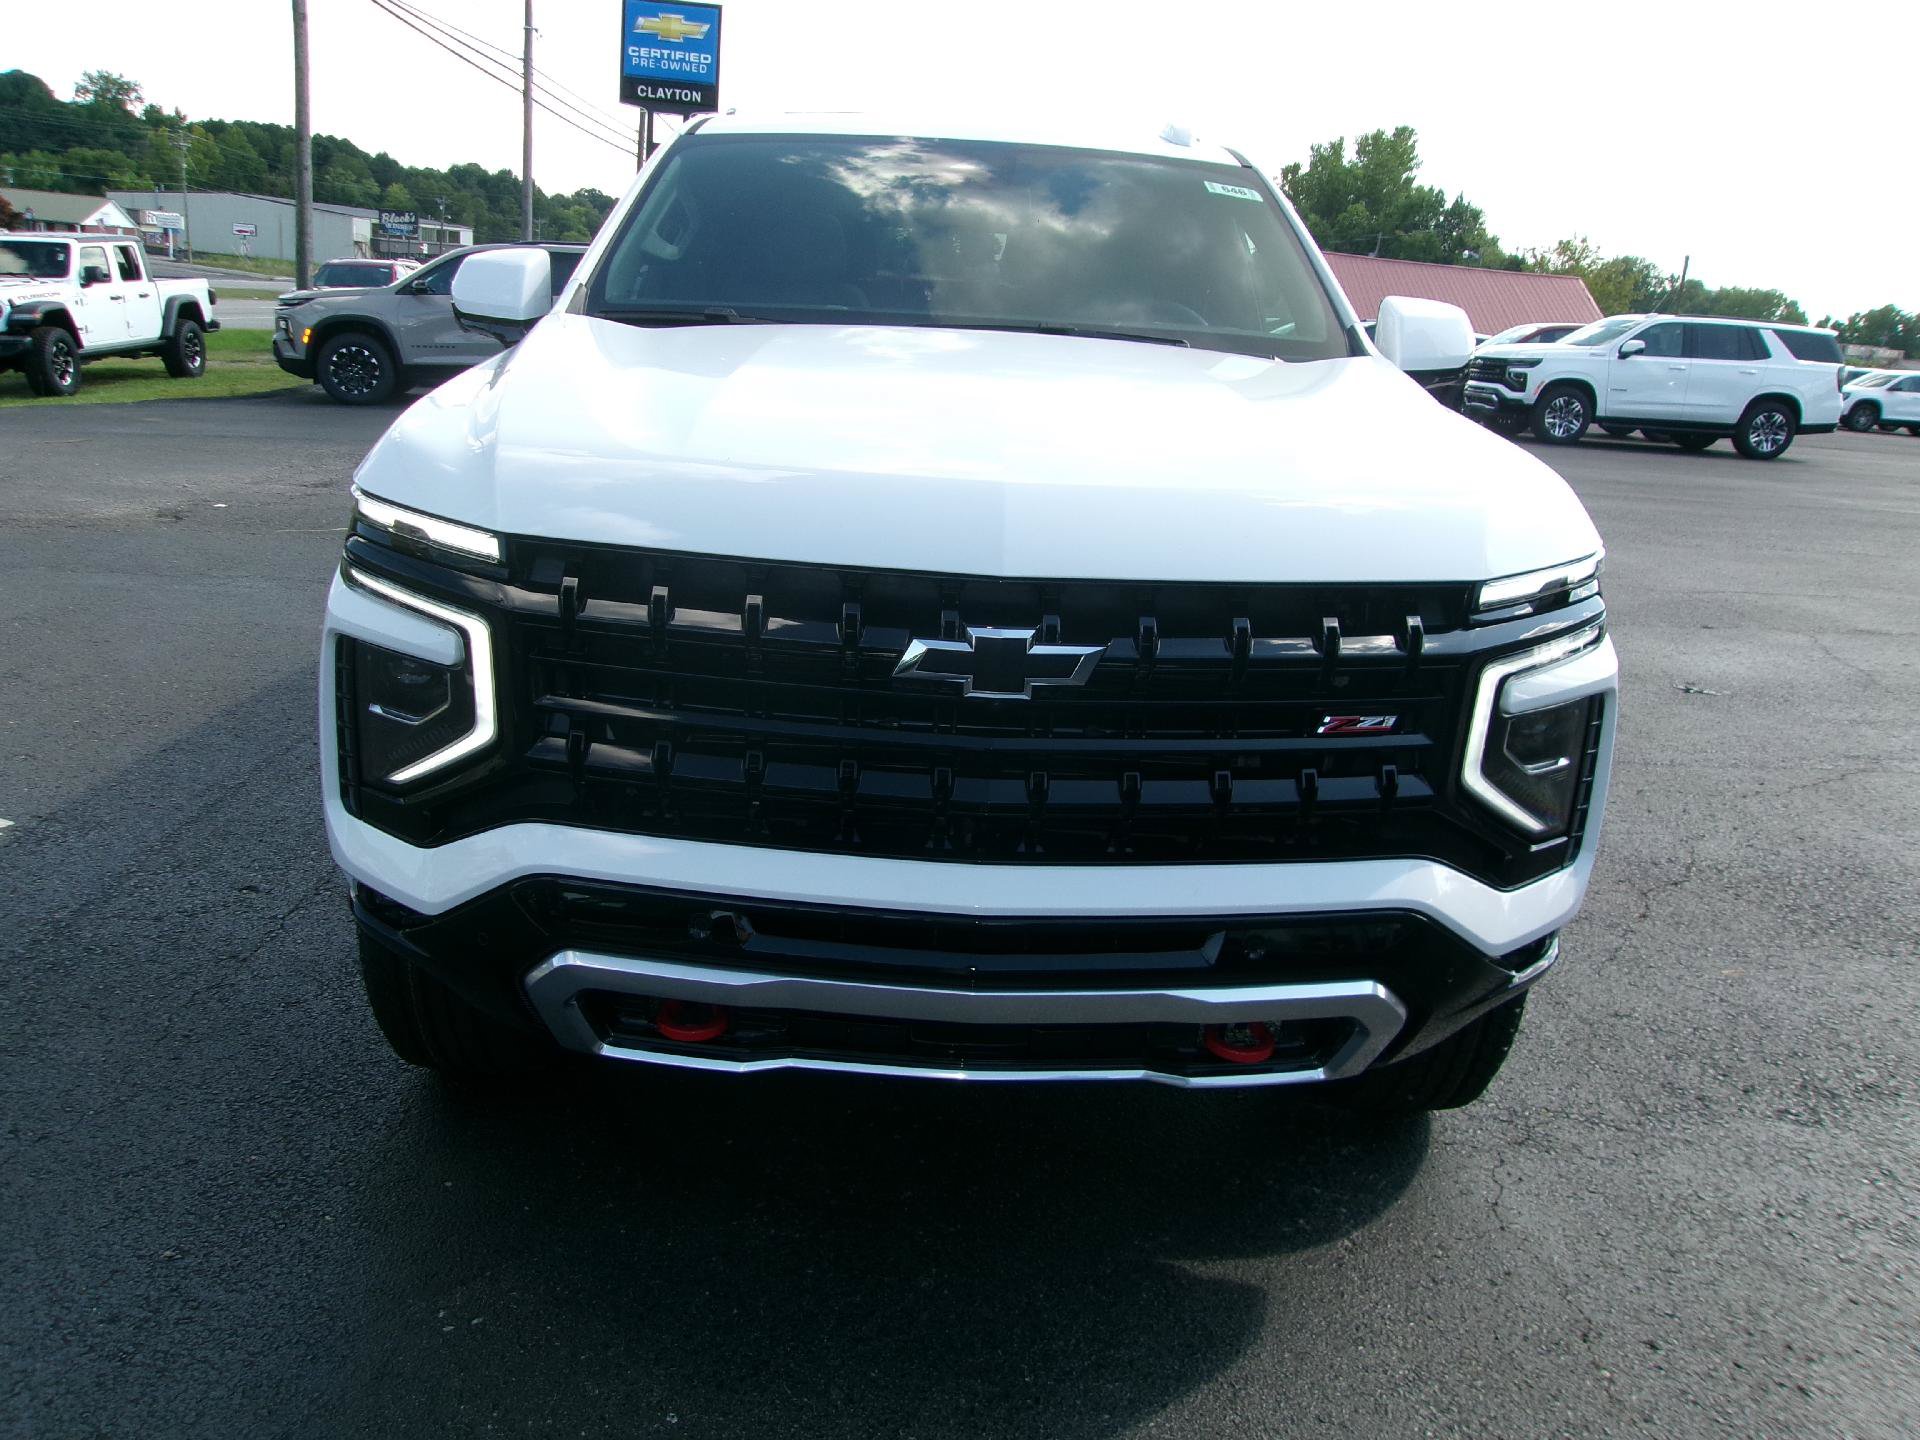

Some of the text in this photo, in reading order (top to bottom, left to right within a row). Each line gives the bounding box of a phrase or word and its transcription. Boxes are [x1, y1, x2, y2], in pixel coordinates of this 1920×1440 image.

[628, 46, 712, 63] CERTIFIED
[632, 57, 707, 73] PRE-OWNED
[637, 85, 701, 102] CLAYTON
[1317, 715, 1398, 734] Z71
